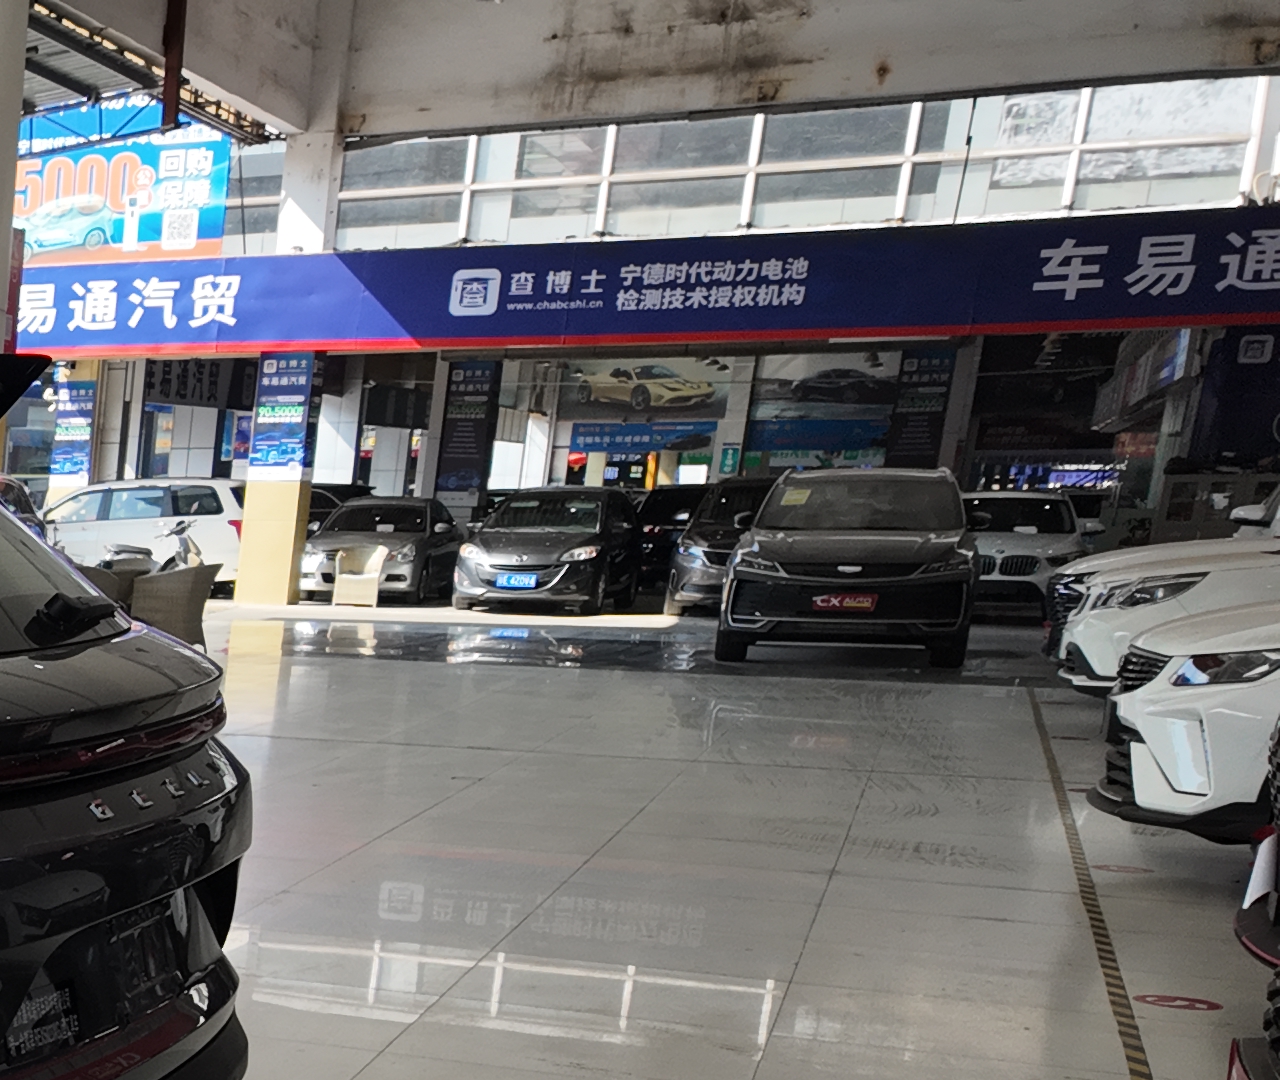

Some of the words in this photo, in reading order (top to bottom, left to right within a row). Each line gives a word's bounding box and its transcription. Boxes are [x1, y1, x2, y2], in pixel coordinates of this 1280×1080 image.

[159, 147, 215, 180] 回购
[156, 178, 212, 211] 保障
[507, 269, 608, 297] 查博士
[619, 257, 810, 286] 宁德时代动力电池
[1032, 229, 1280, 302] 车易通
[17, 274, 242, 334] 易通汽贸
[615, 284, 806, 312] 检测技术授权机构
